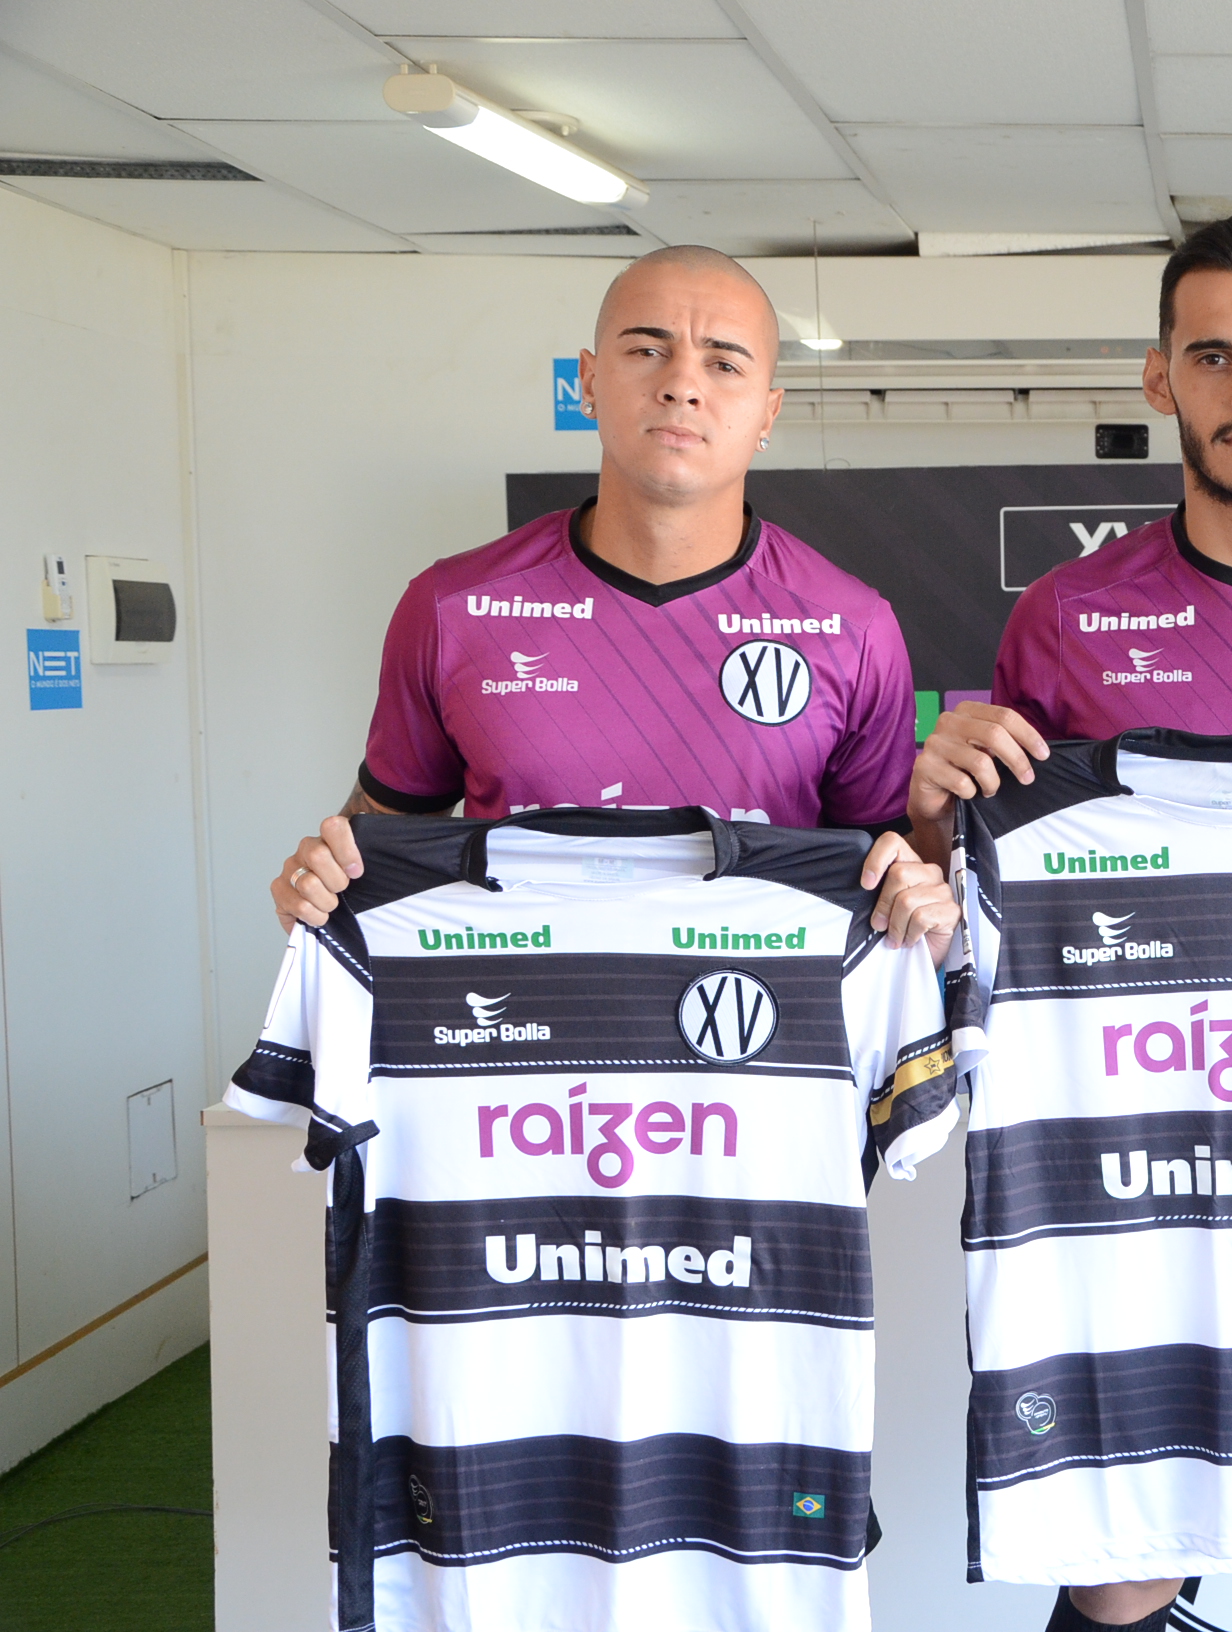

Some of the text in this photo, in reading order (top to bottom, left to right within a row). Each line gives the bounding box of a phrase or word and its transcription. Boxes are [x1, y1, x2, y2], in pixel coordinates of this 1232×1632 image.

[467, 595, 594, 620] Unimed
[1079, 605, 1196, 633] Unimed
[717, 612, 842, 635] Unimed
[30, 651, 79, 676] NET
[481, 677, 579, 696] Super Bolla
[737, 645, 801, 718] XV
[1102, 669, 1193, 686] Super Bolla
[1043, 846, 1171, 875] Unimed
[418, 924, 552, 951] Unimed
[671, 926, 808, 950] Unimed
[1062, 940, 1174, 967] Super Bolla
[695, 975, 764, 1058] XV
[433, 1022, 551, 1047] Super Bolla
[477, 1081, 739, 1190] raízen
[485, 1230, 752, 1288] Unimed
